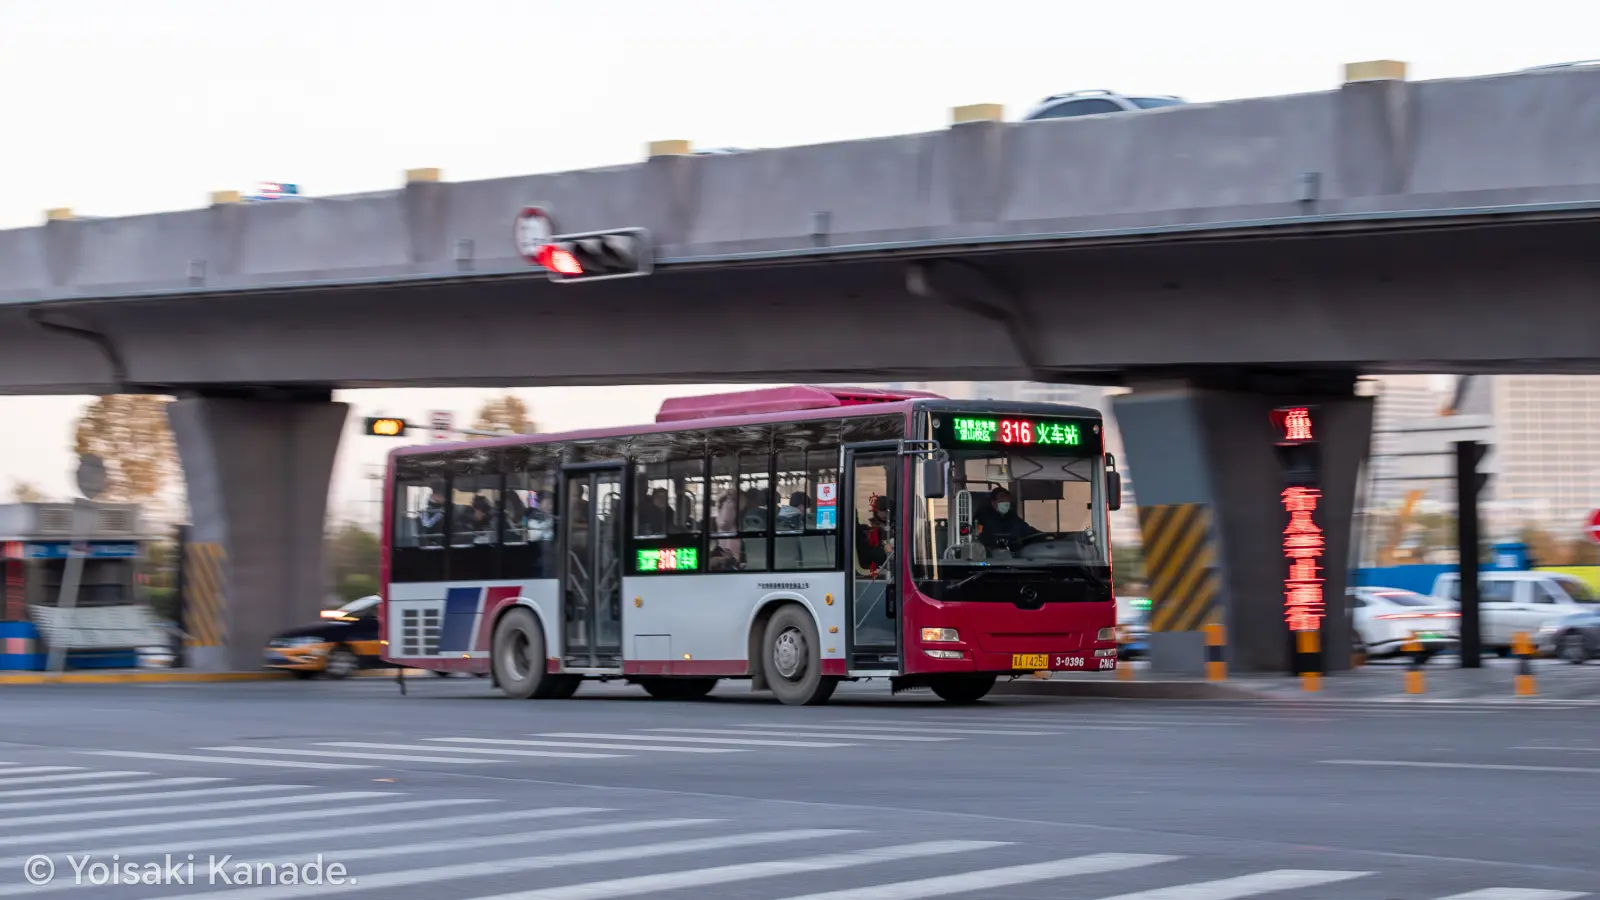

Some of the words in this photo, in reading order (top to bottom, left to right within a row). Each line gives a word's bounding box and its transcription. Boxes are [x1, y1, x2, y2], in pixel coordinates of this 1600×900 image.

[1002, 420, 1031, 442] 316
[1036, 422, 1079, 444] 火车站
[658, 549, 676, 569] 316
[1099, 658, 1114, 669] CNG
